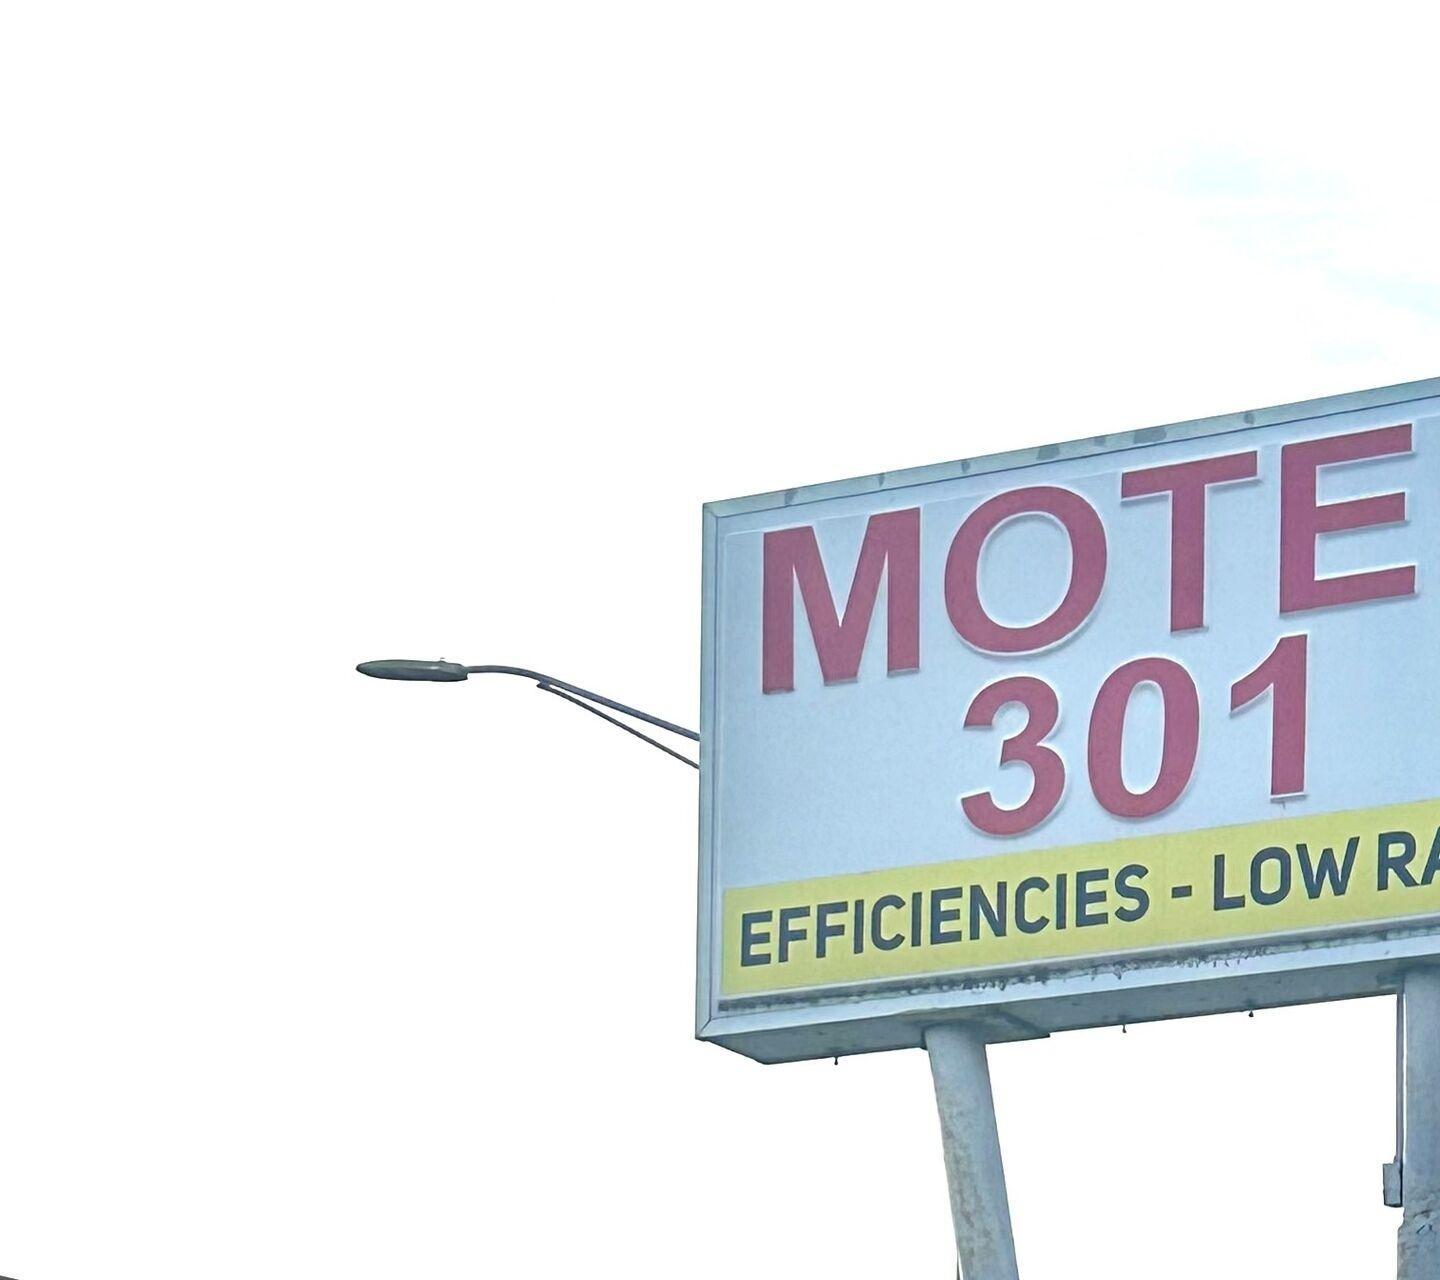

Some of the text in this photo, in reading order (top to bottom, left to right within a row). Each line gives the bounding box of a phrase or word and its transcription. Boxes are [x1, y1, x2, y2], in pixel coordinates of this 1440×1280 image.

[962, 634, 1307, 836] 301
[740, 863, 1150, 967] EFFICIENCIES
[1213, 836, 1361, 912] LOW
